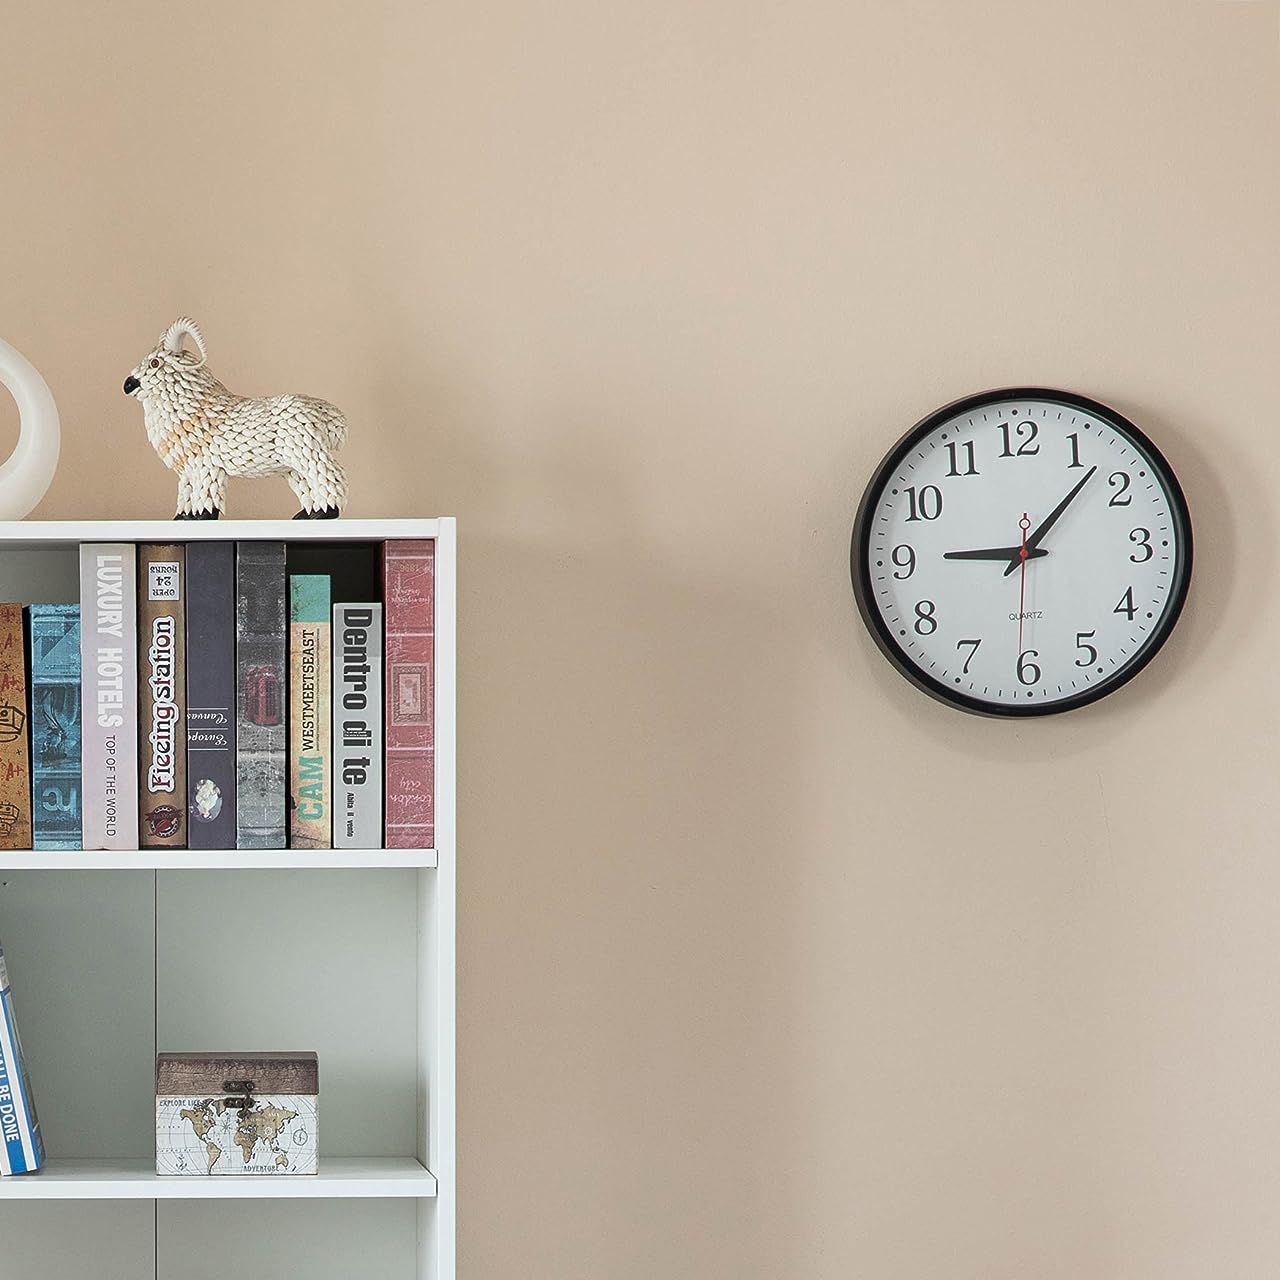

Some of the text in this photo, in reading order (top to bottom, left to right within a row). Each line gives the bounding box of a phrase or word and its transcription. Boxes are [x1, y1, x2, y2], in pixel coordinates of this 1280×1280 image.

[997, 421, 1040, 458] 12
[1065, 433, 1084, 468] 1
[943, 440, 980, 477] 11
[903, 485, 943, 522] 10
[1108, 471, 1132, 507] 2
[891, 544, 916, 580] 9
[1129, 527, 1153, 562] 3
[156, 576, 172, 586] 24
[913, 600, 938, 635] 8
[1008, 610, 1043, 621] QUARTZ
[1113, 585, 1139, 621] 4
[96, 555, 122, 728] LUXURY HOTELS
[152, 620, 171, 699] station
[342, 608, 372, 711] Dentro
[956, 638, 982, 674] 7
[1074, 629, 1098, 667] 5
[1016, 649, 1041, 685] 6
[298, 630, 324, 822] CAM WESTMEETSEAST
[342, 721, 372, 747] di
[106, 735, 116, 837] TOP OF THE WORLD
[342, 757, 371, 786] te
[347, 792, 355, 809] Abita
[347, 819, 355, 838] vento
[0, 1103, 19, 1142] DONE
